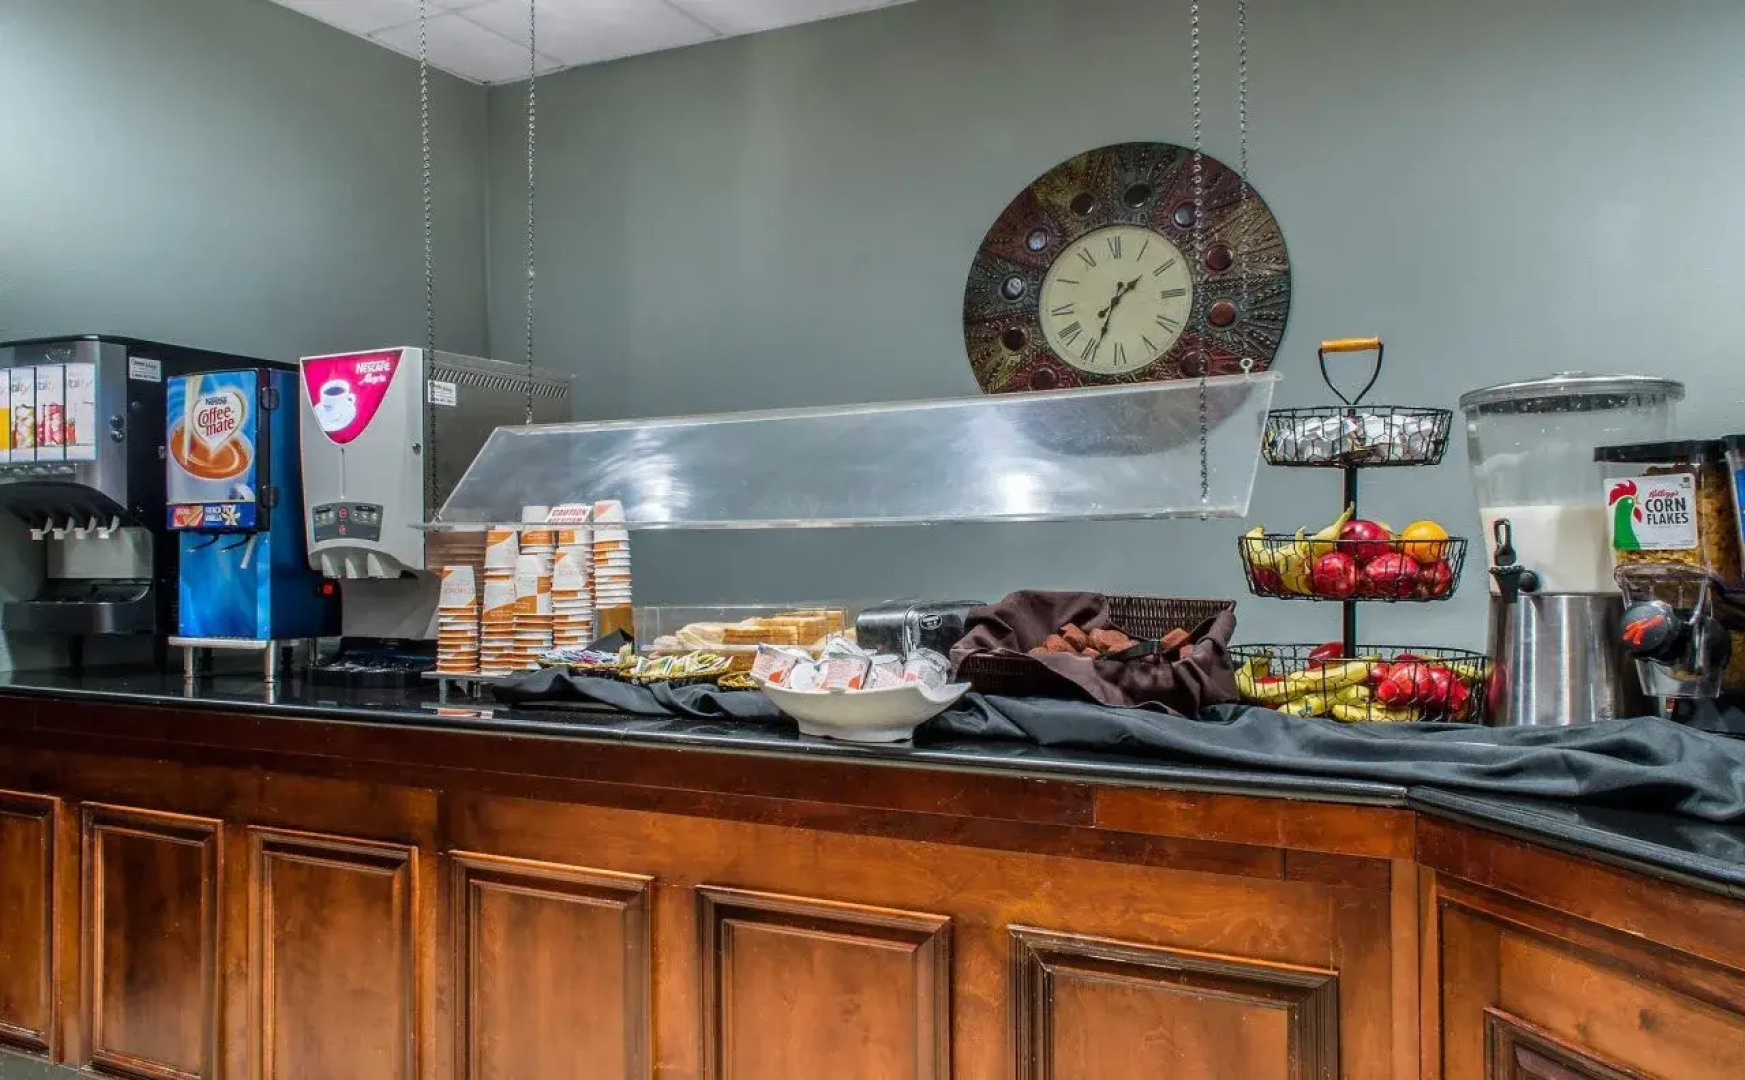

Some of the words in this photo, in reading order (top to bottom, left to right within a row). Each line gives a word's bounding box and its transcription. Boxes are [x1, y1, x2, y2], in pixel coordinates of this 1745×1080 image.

[206, 418, 235, 436] mate
[1645, 497, 1686, 513] CORN
[1646, 512, 1689, 525] FLAKES
